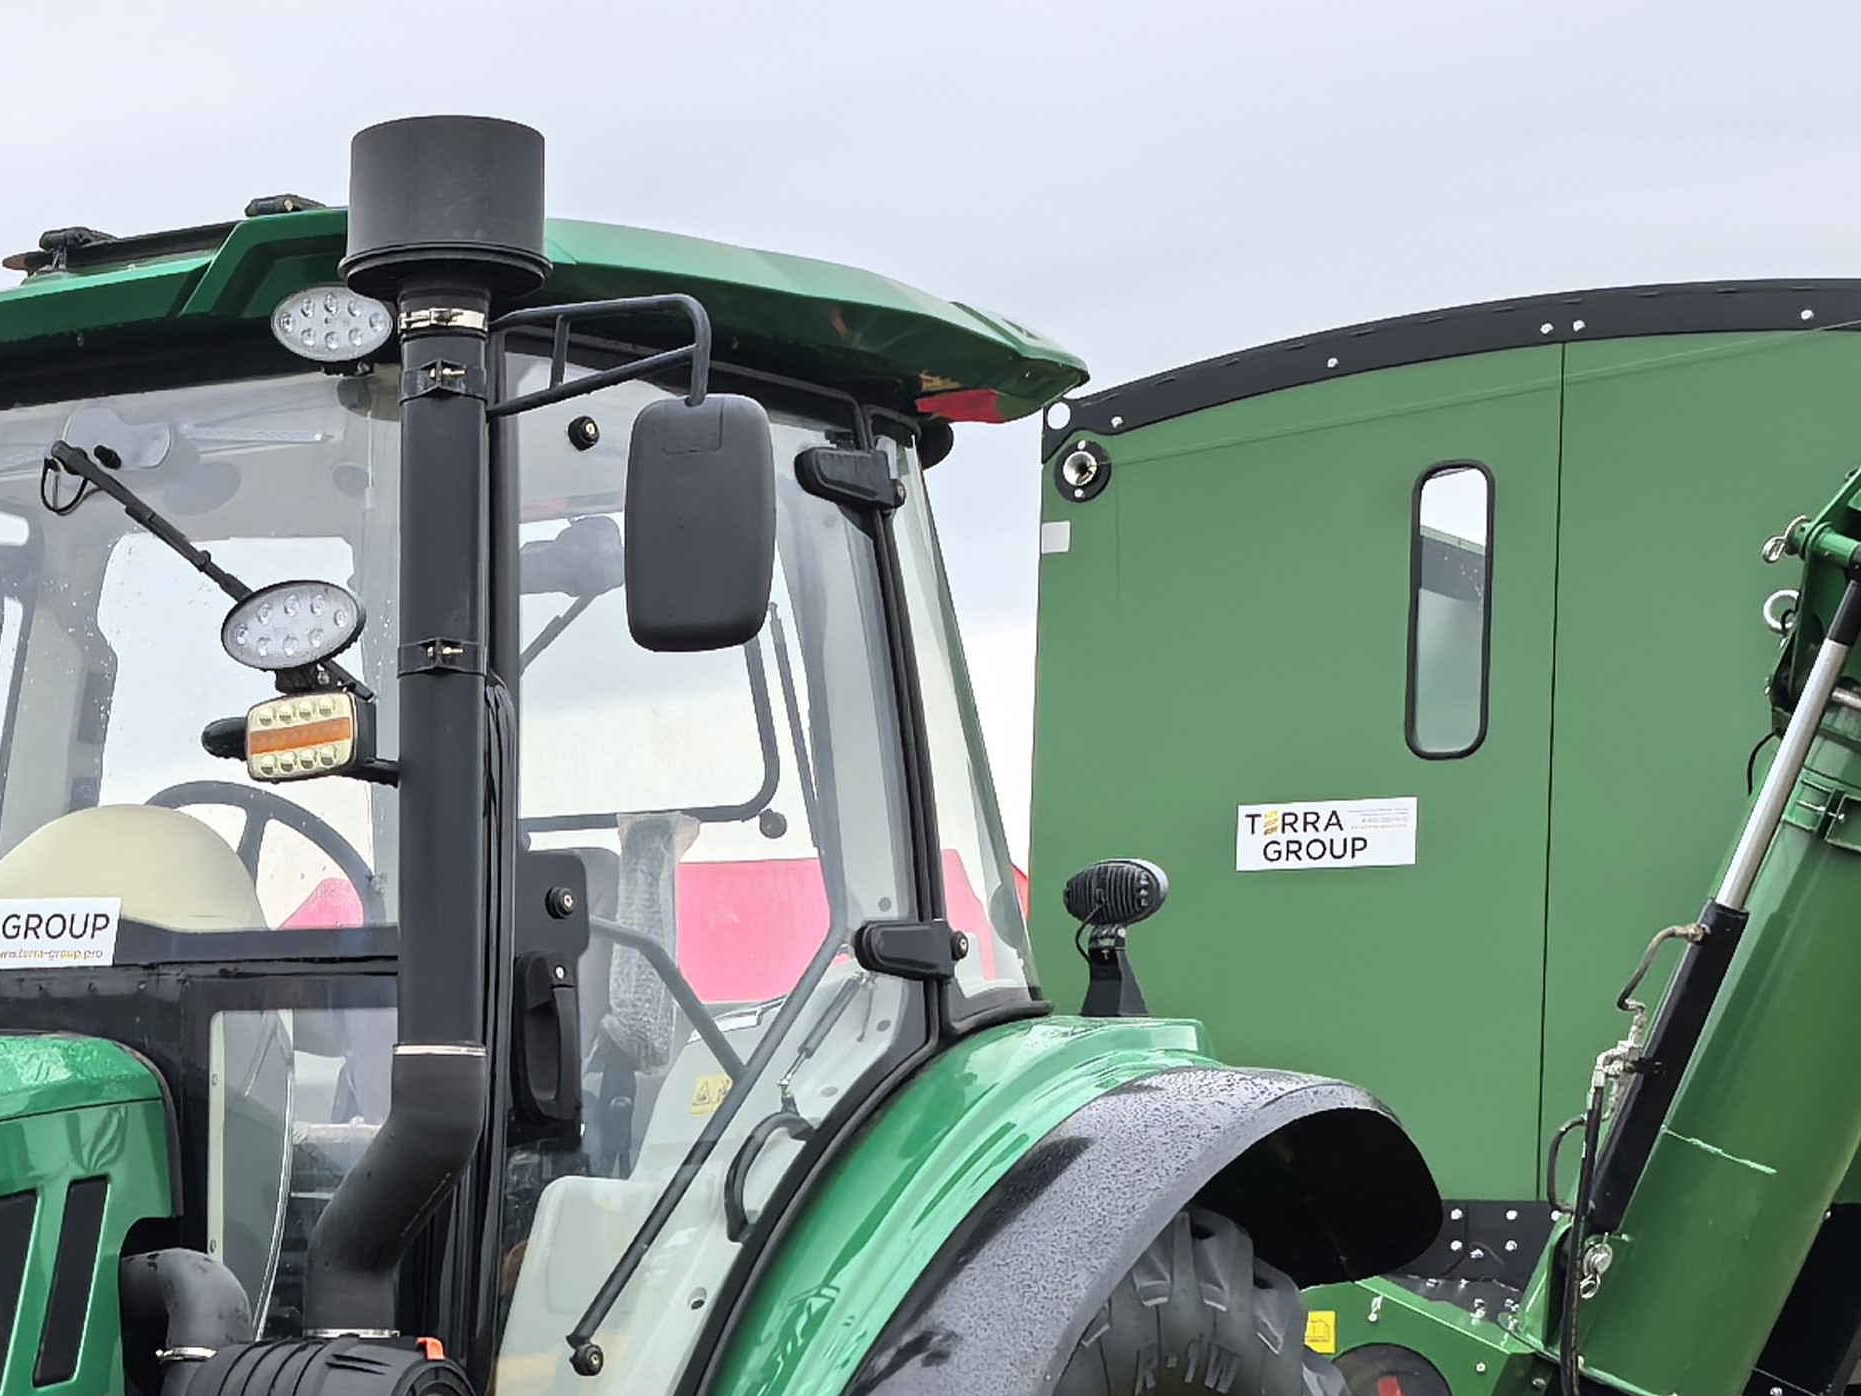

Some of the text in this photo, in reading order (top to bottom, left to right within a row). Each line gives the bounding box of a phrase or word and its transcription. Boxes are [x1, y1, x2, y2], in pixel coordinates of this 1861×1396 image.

[1245, 810, 1344, 836] TERRA
[1263, 837, 1368, 862] GROUP
[2, 912, 110, 940] GROUP
